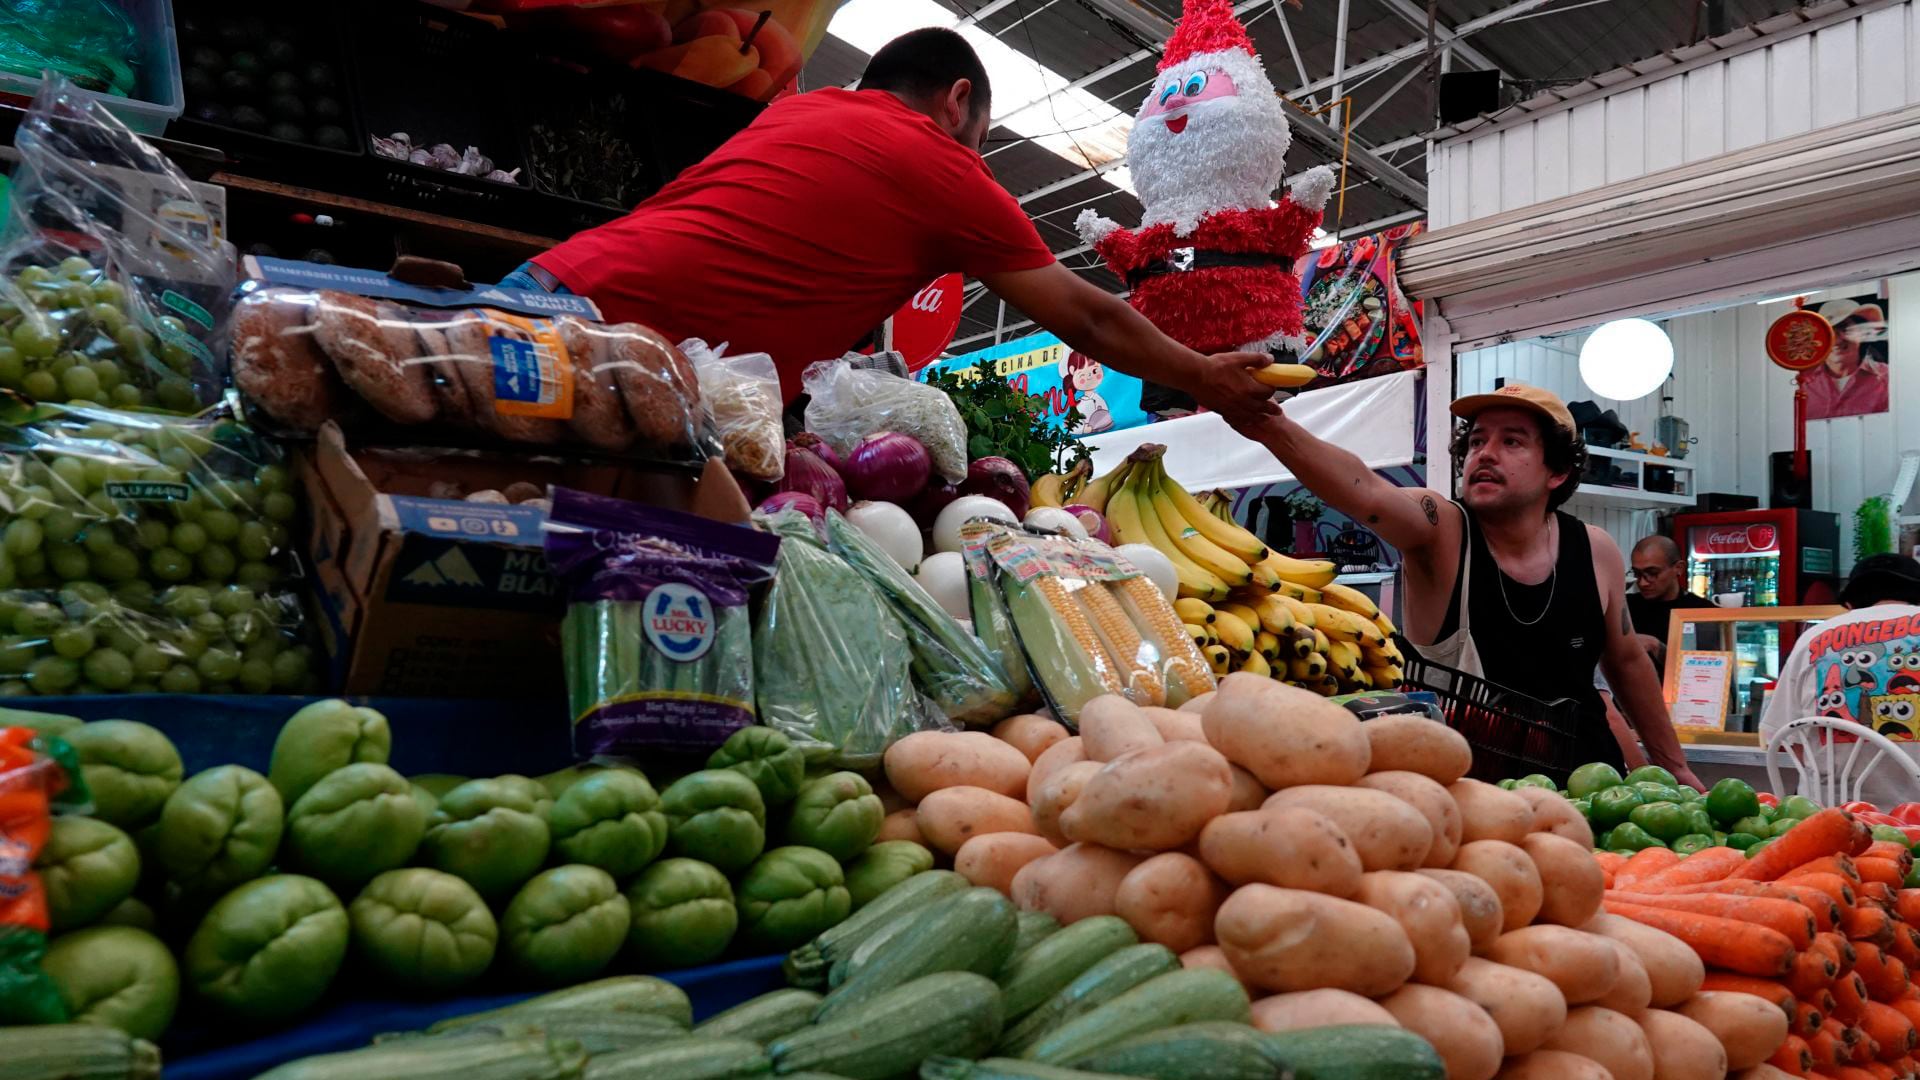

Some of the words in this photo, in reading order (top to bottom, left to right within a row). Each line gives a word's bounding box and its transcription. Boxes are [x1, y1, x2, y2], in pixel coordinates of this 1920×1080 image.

[520, 293, 580, 305] MONTE
[525, 300, 586, 312] BLANCO
[1043, 347, 1058, 363] DE
[110, 486, 142, 498] PLU
[1709, 531, 1747, 545] Coca-Cola
[652, 618, 708, 636] LUCKY
